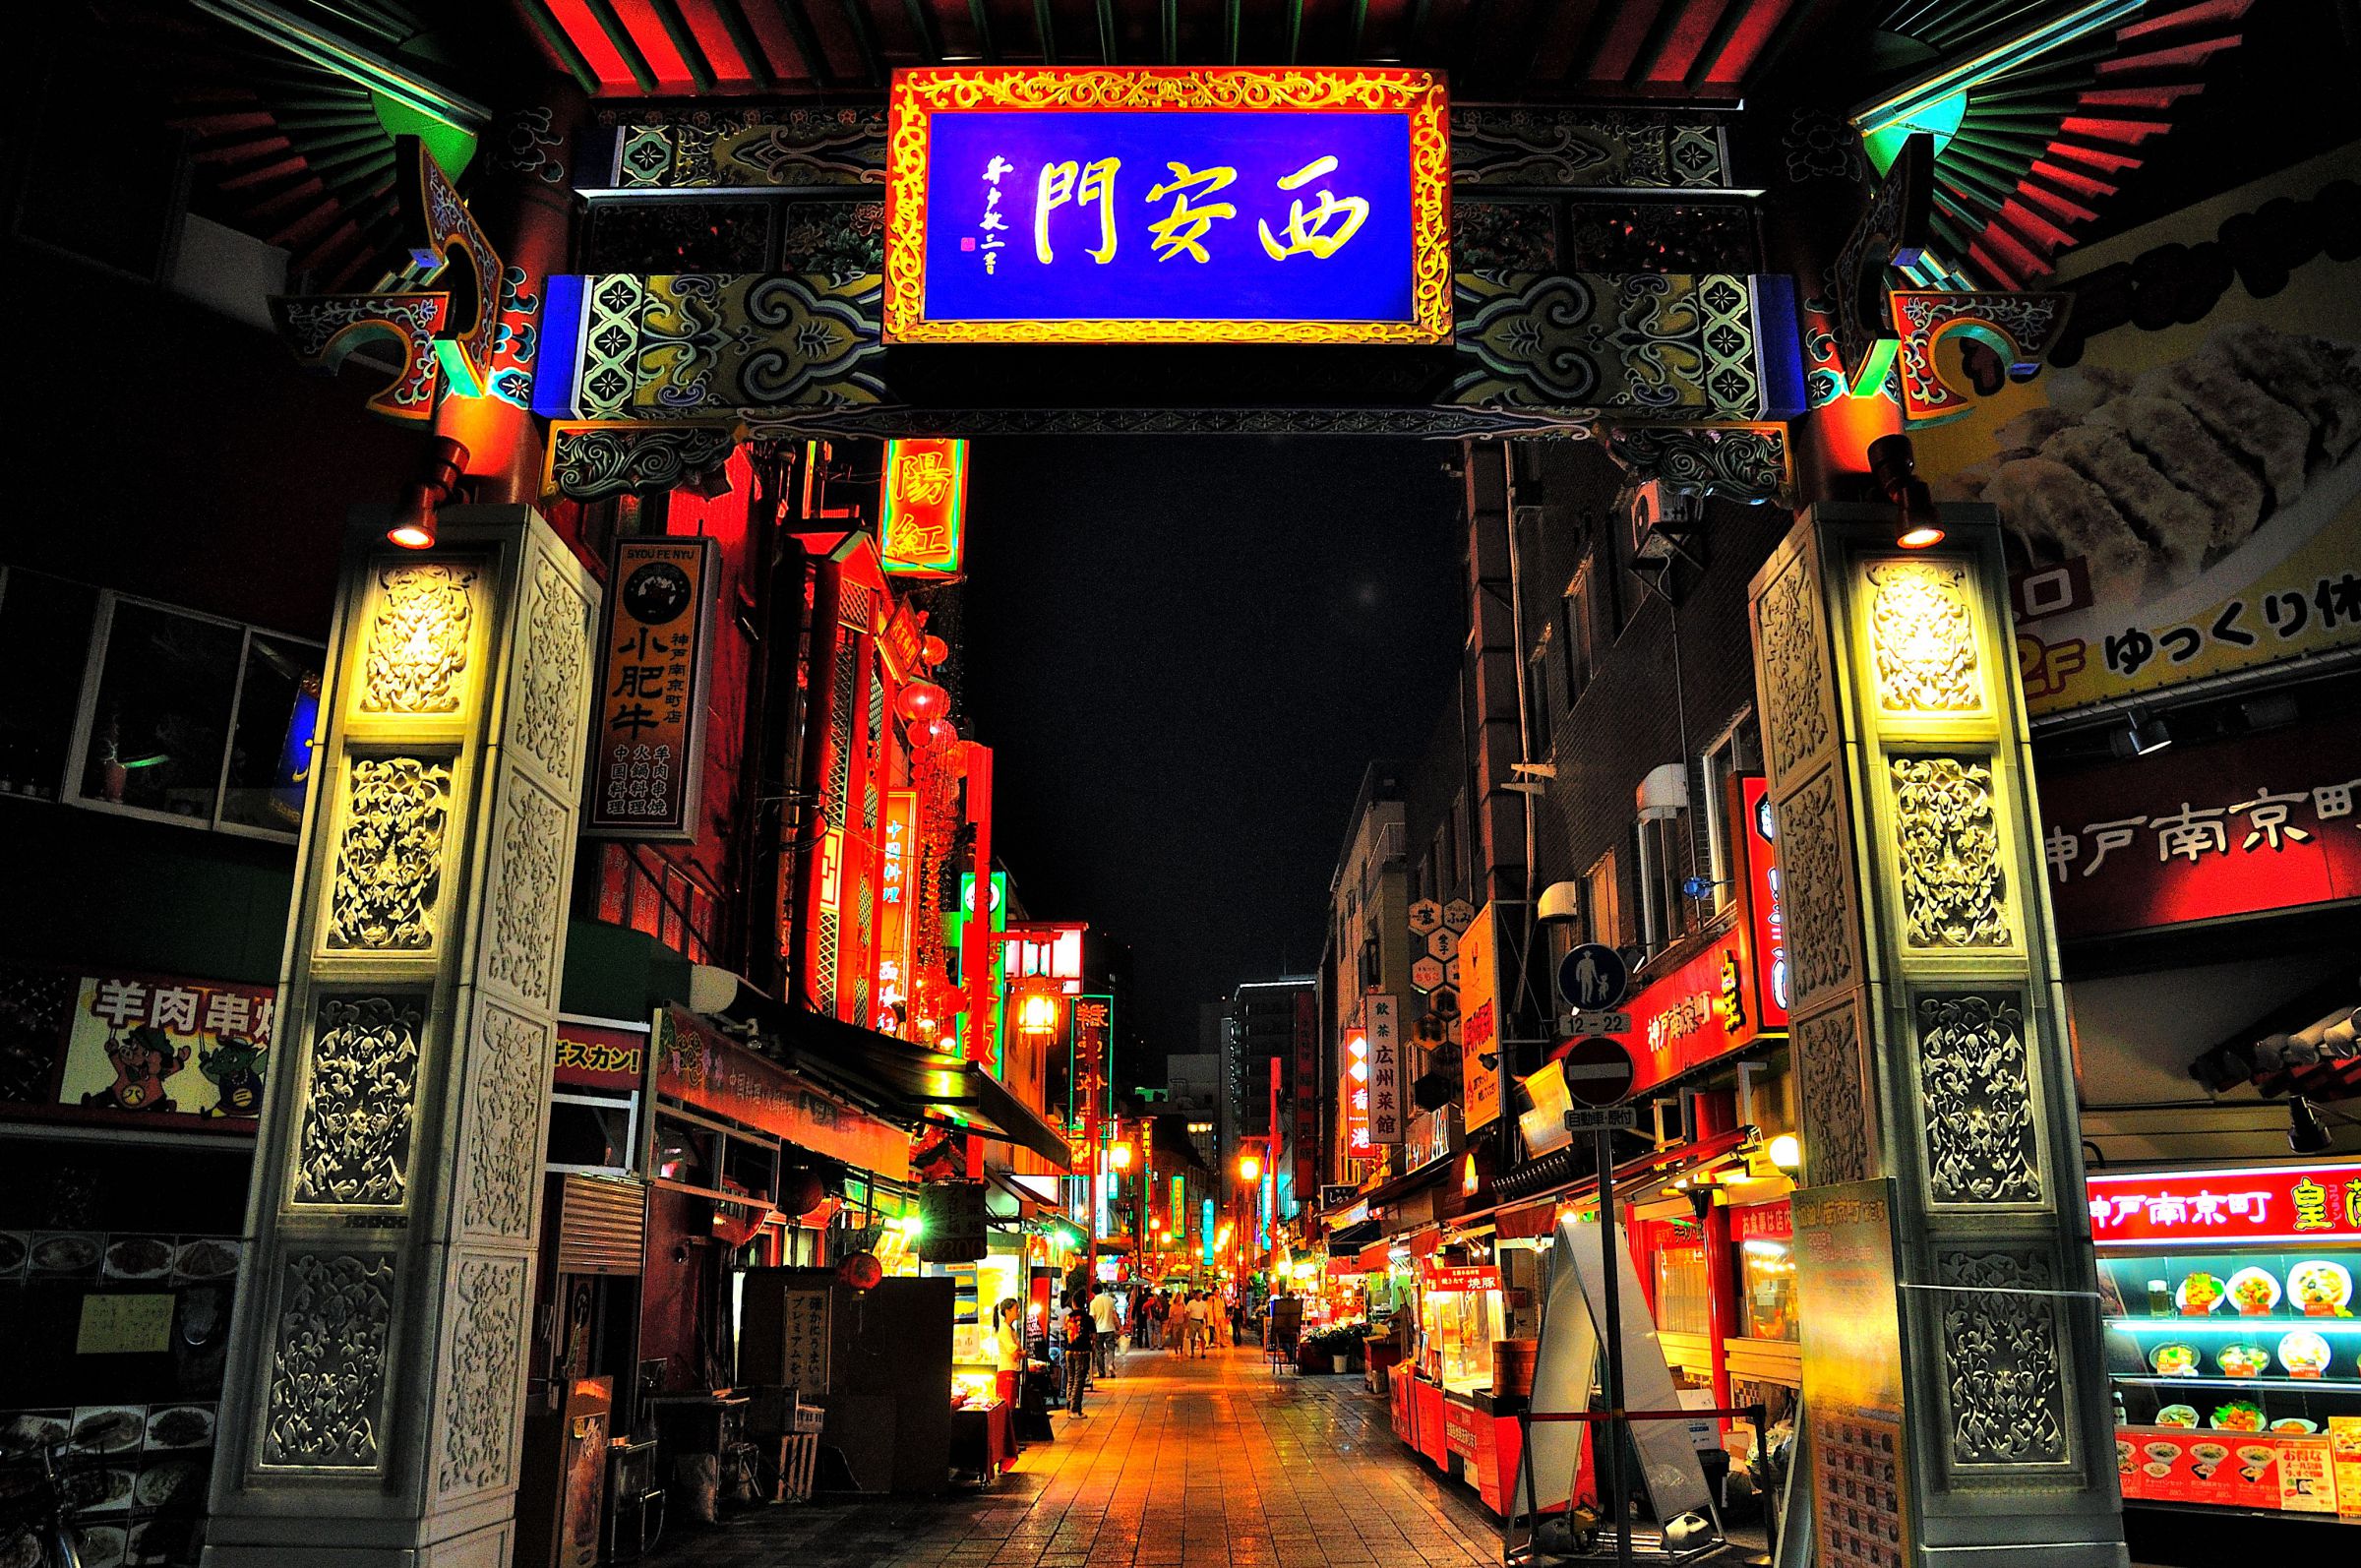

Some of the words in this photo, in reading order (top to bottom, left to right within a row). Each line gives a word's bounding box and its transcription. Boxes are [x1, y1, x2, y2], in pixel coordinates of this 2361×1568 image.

[1034, 154, 1370, 265] 西安門
[608, 628, 669, 740] 小肥牛
[663, 633, 689, 724] 神戸南京町店
[607, 744, 629, 815] 中国料理
[628, 744, 651, 815] 火鍋料理
[647, 744, 671, 815] 羊肉串焼
[1568, 1017, 1585, 1033] 12
[1603, 1015, 1623, 1032] 22
[1647, 991, 1712, 1053] 神戸南京町
